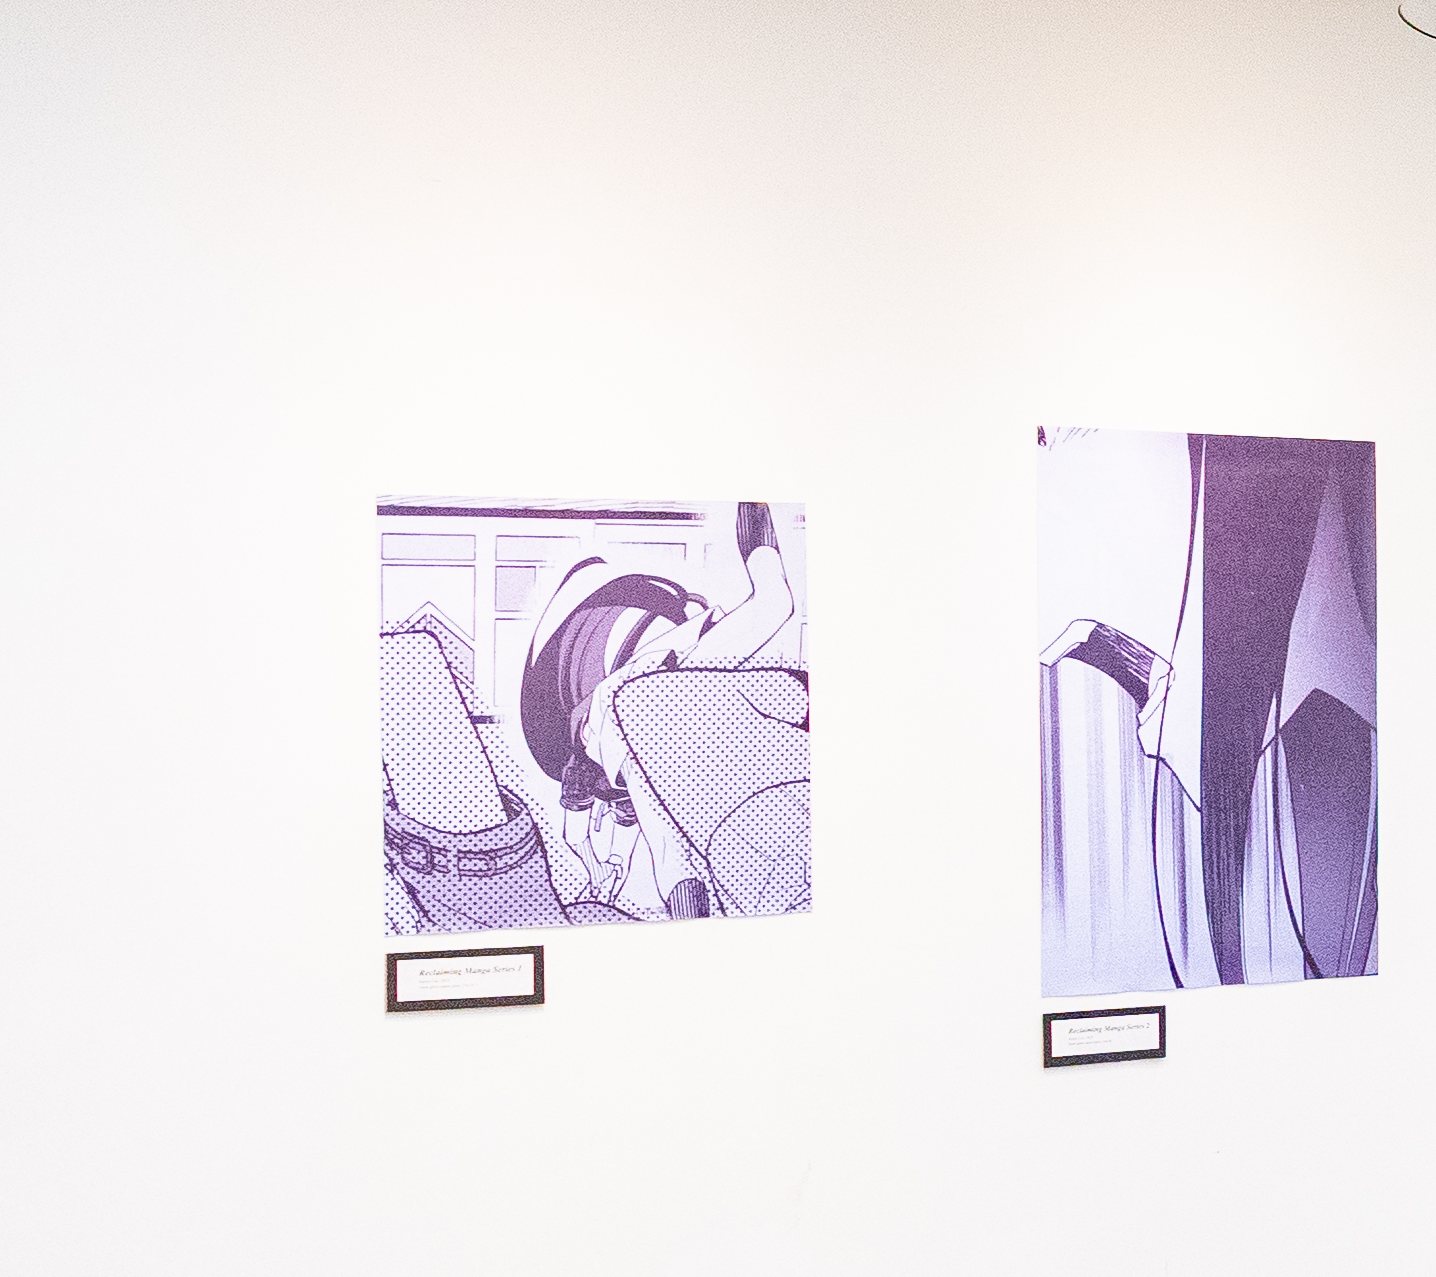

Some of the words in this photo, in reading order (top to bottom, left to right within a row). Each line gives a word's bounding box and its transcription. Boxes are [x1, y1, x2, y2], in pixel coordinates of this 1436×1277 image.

[419, 968, 462, 976] Reclaiming
[465, 967, 491, 975] Manga
[492, 965, 516, 973] Series
[1069, 1026, 1103, 1034] Reclaiming
